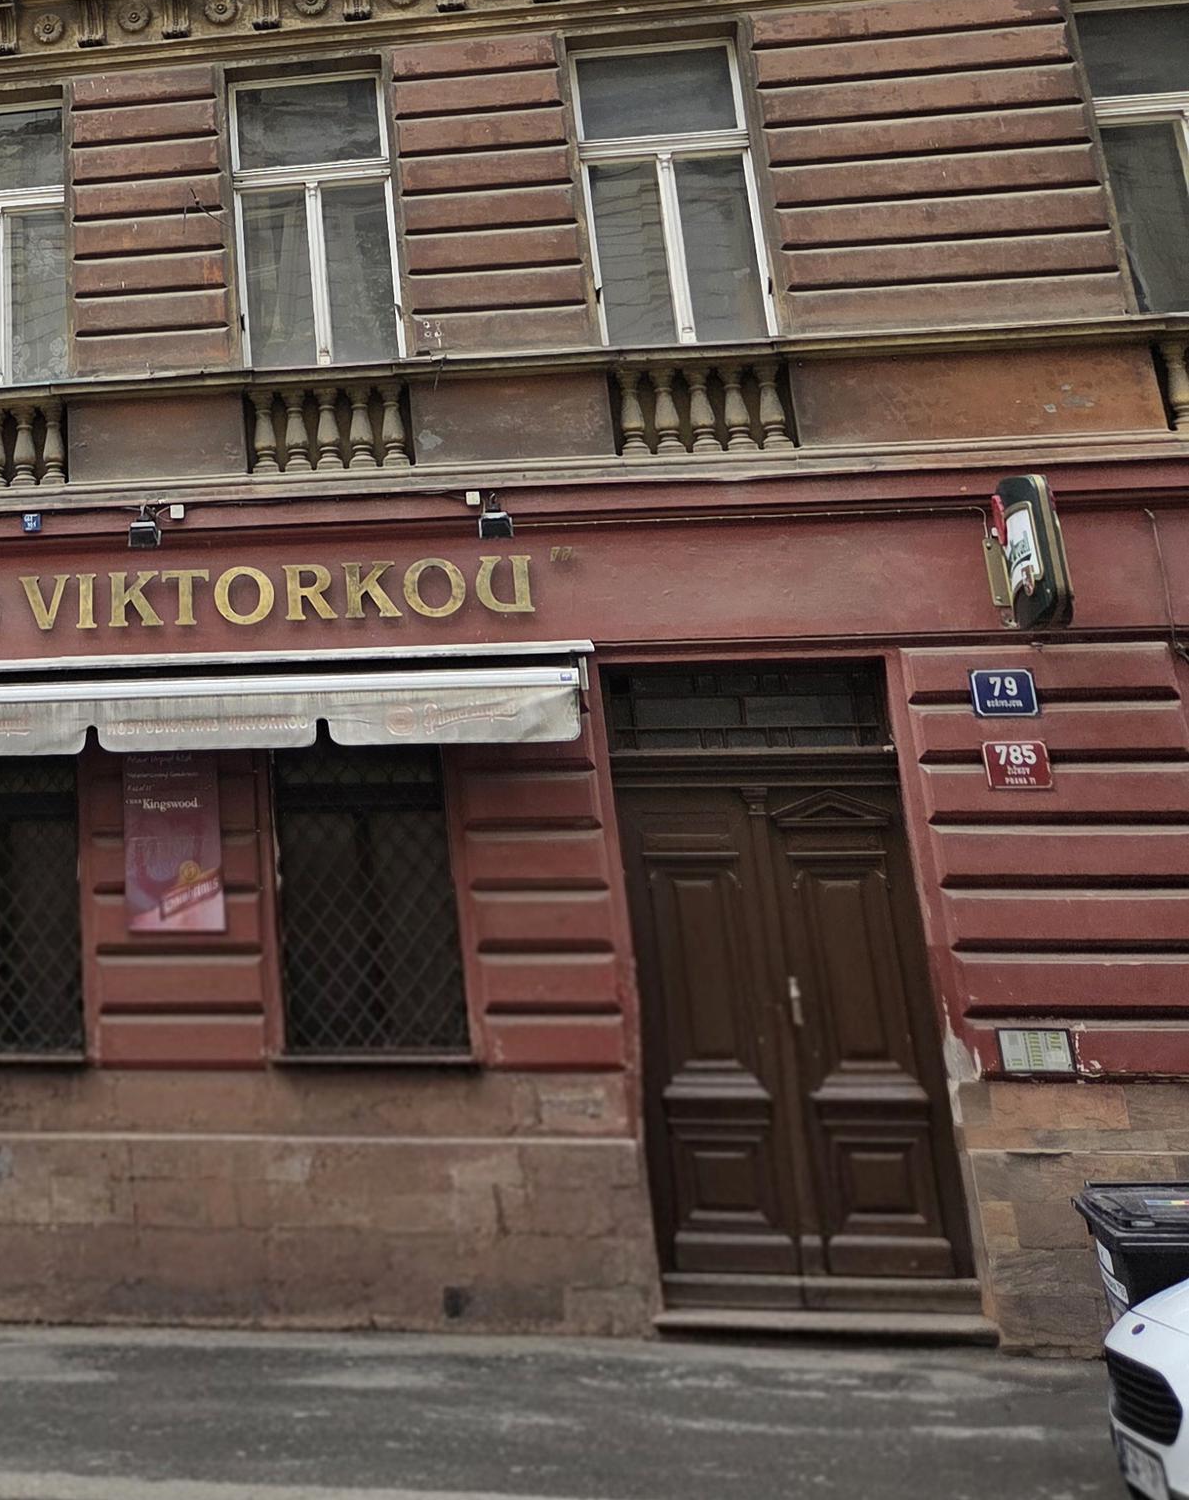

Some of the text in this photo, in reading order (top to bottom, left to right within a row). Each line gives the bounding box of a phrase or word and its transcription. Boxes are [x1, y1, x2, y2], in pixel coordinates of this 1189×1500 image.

[988, 676, 1018, 697] 79
[994, 745, 1037, 765] 785
[142, 797, 198, 812] Kingswood
